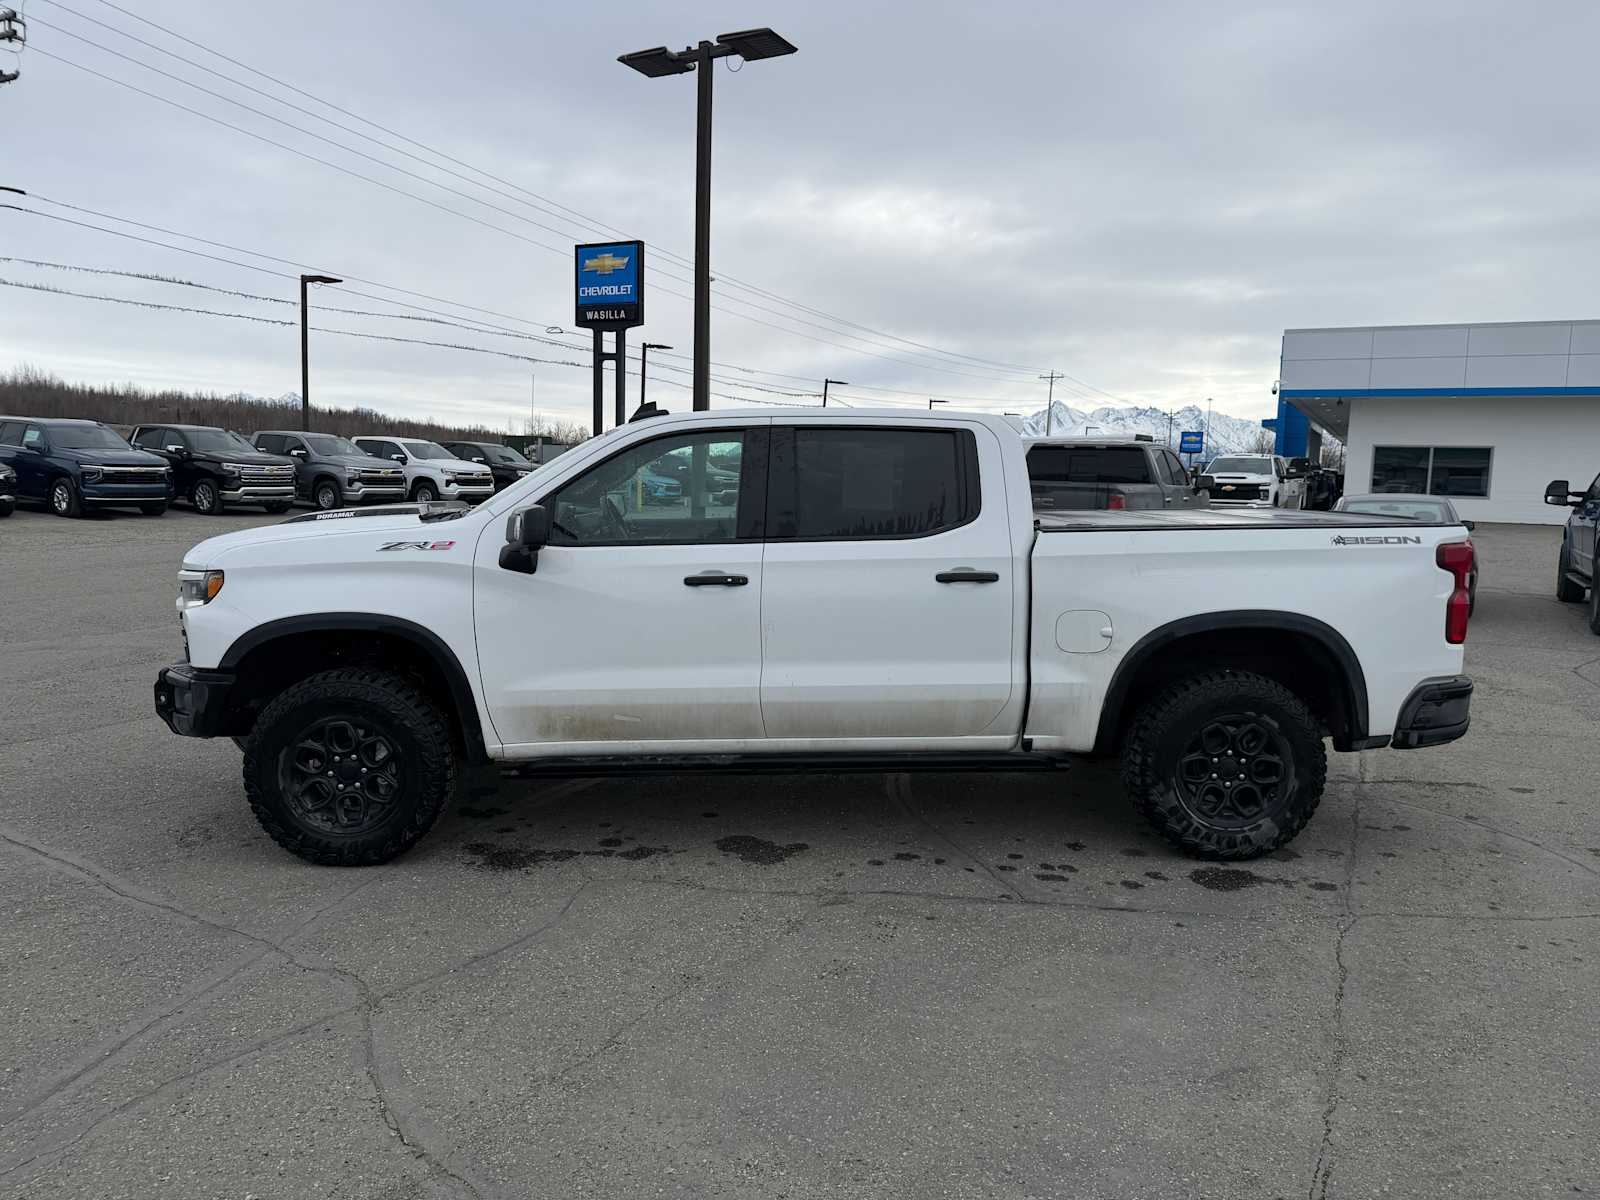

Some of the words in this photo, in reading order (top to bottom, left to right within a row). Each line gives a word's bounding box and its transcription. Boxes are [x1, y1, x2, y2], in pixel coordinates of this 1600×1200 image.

[580, 285, 633, 297] CHEVROLET
[586, 309, 626, 320] WASILLA
[316, 511, 356, 520] DURAMAX
[1342, 535, 1421, 545] BISON
[376, 541, 456, 552] ZR2
